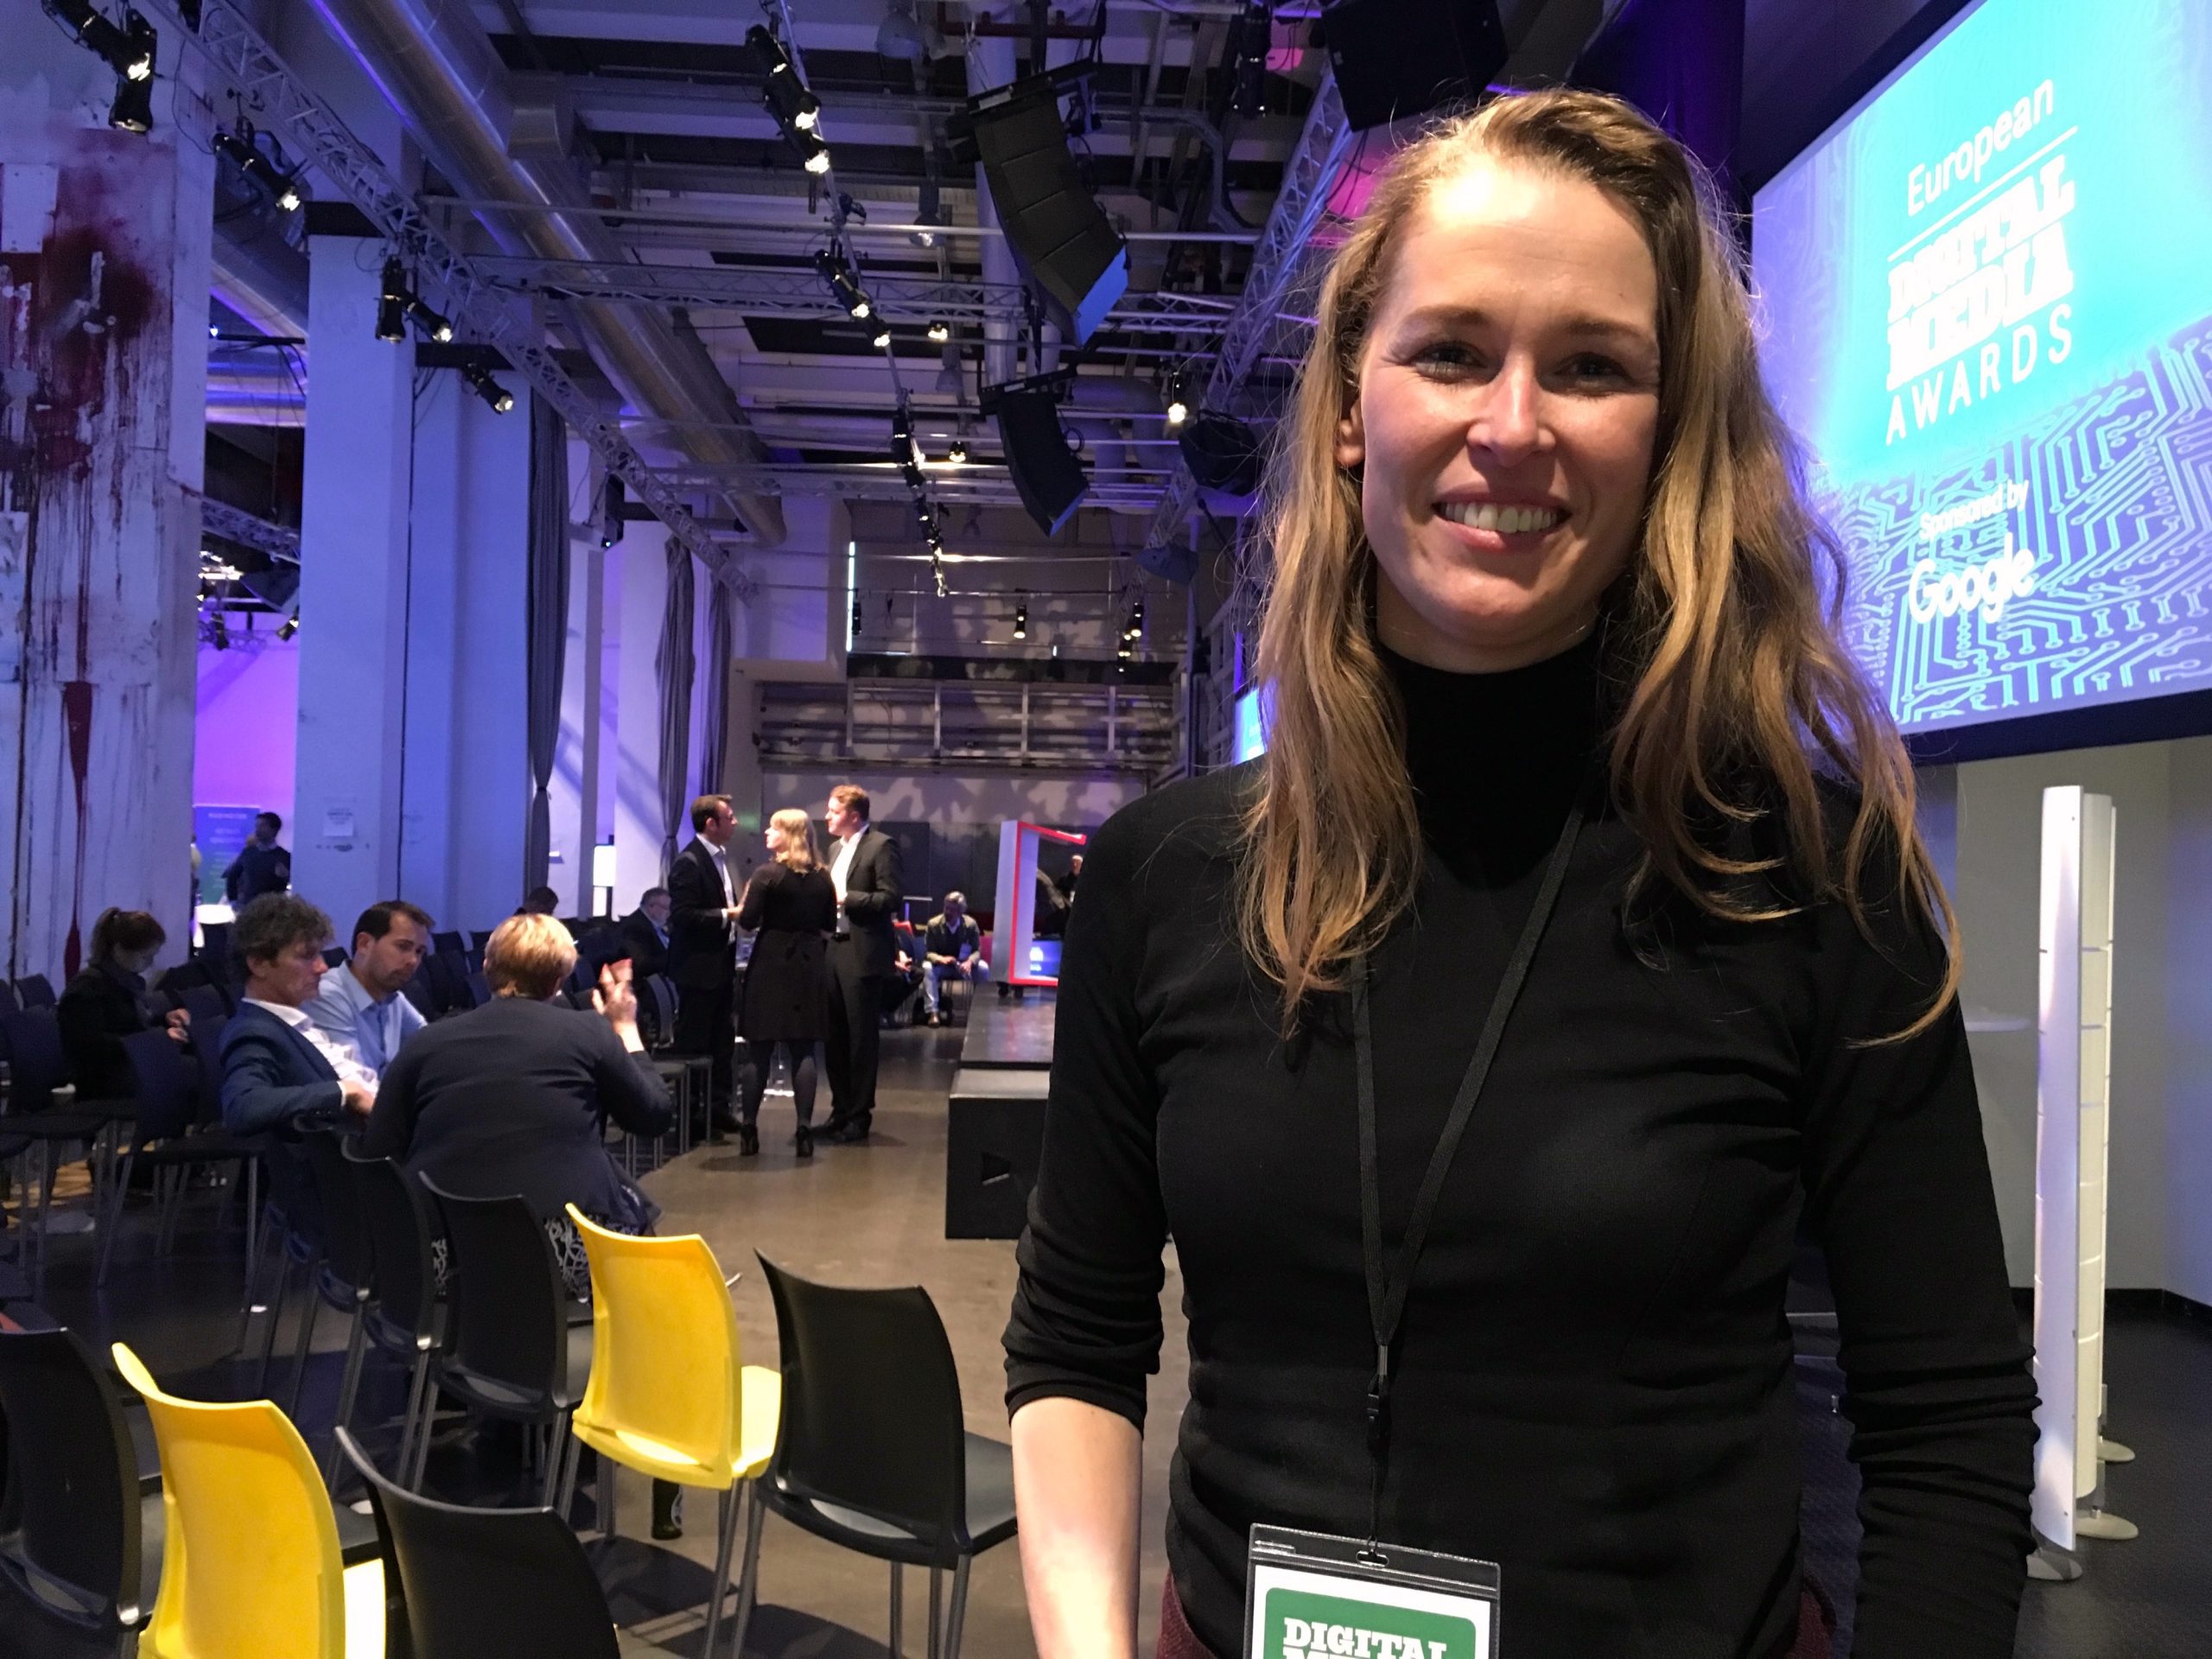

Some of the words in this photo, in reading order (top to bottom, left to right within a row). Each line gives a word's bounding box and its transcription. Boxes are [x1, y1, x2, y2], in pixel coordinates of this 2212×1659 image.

[1907, 79, 2054, 216] European
[1886, 220, 2075, 392] MEDIA
[1887, 154, 2075, 324] DIGITAL
[1885, 303, 2072, 446] AWARDS
[2006, 479, 2030, 512] by
[1908, 531, 2035, 624] Google
[1283, 1617, 1447, 1659] DIGITAL
